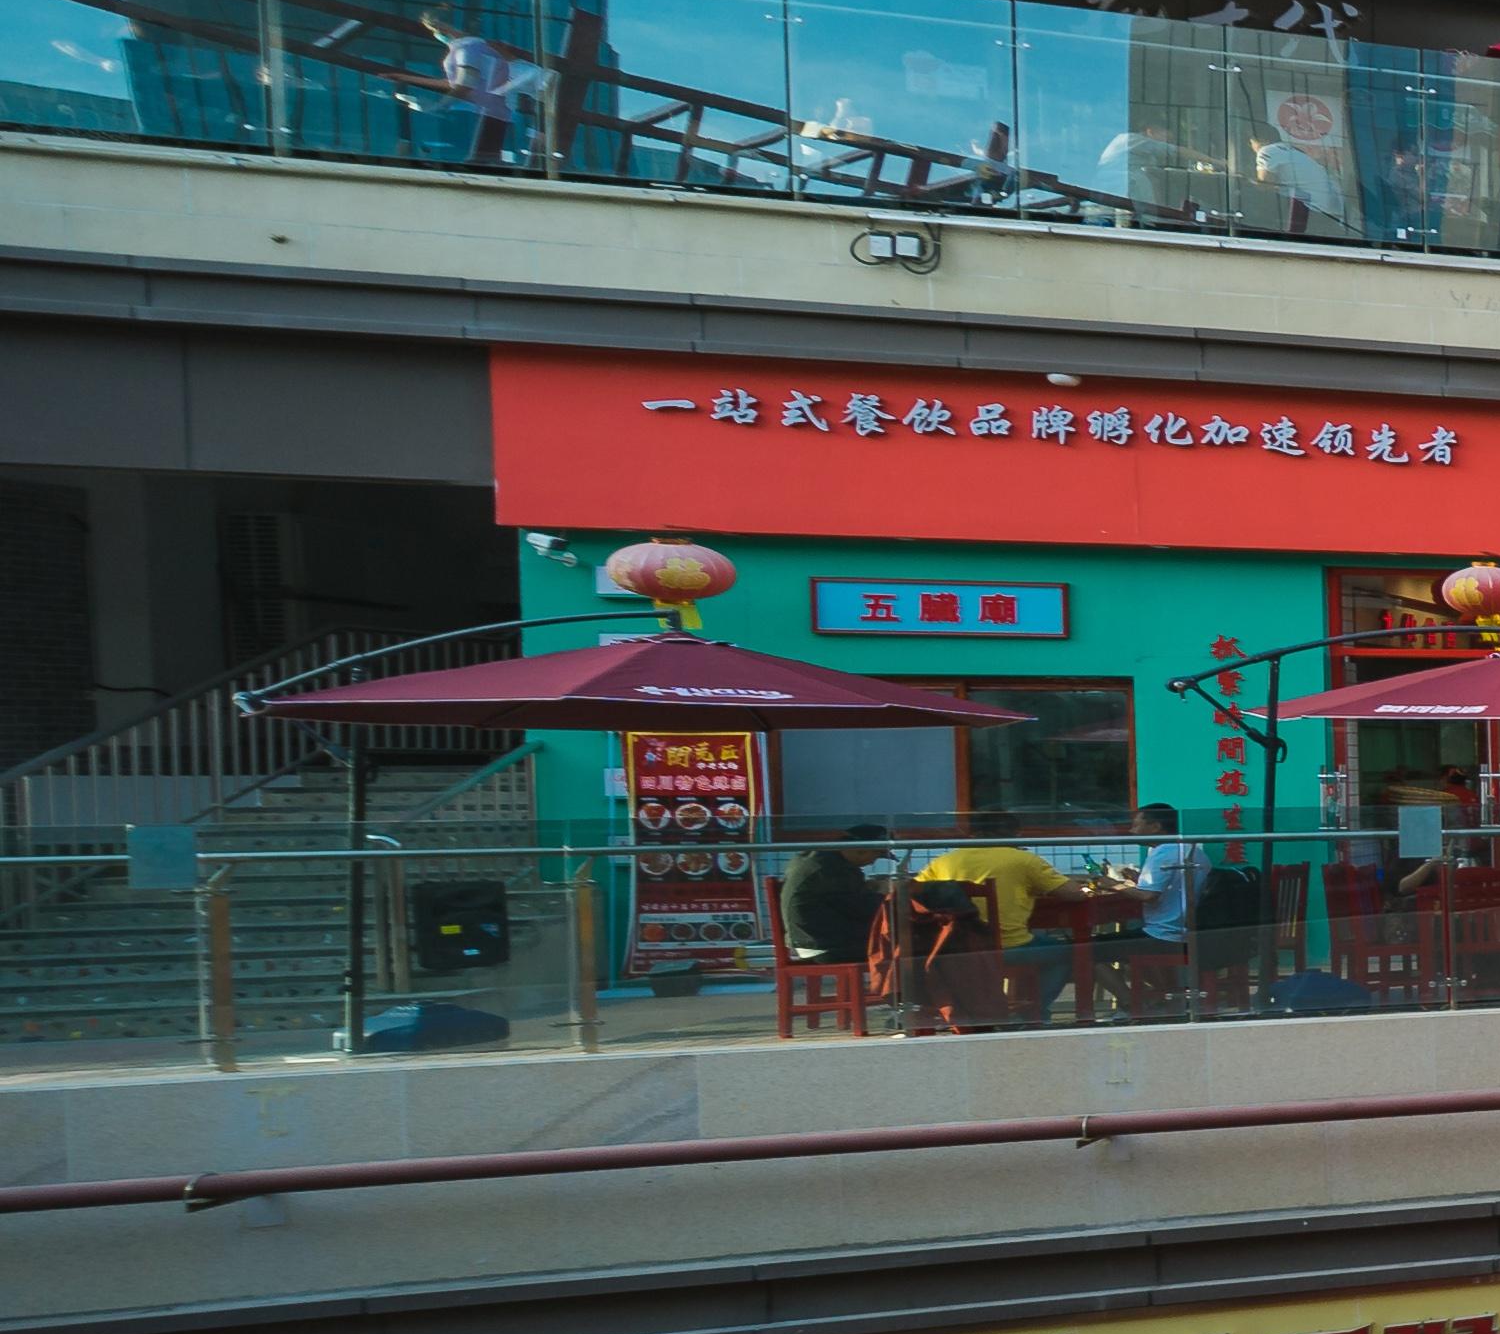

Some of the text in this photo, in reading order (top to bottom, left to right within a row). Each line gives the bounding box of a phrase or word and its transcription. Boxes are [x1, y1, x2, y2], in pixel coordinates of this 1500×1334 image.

[641, 387, 1459, 465] 一站式餐饮品牌孵化加速领先者
